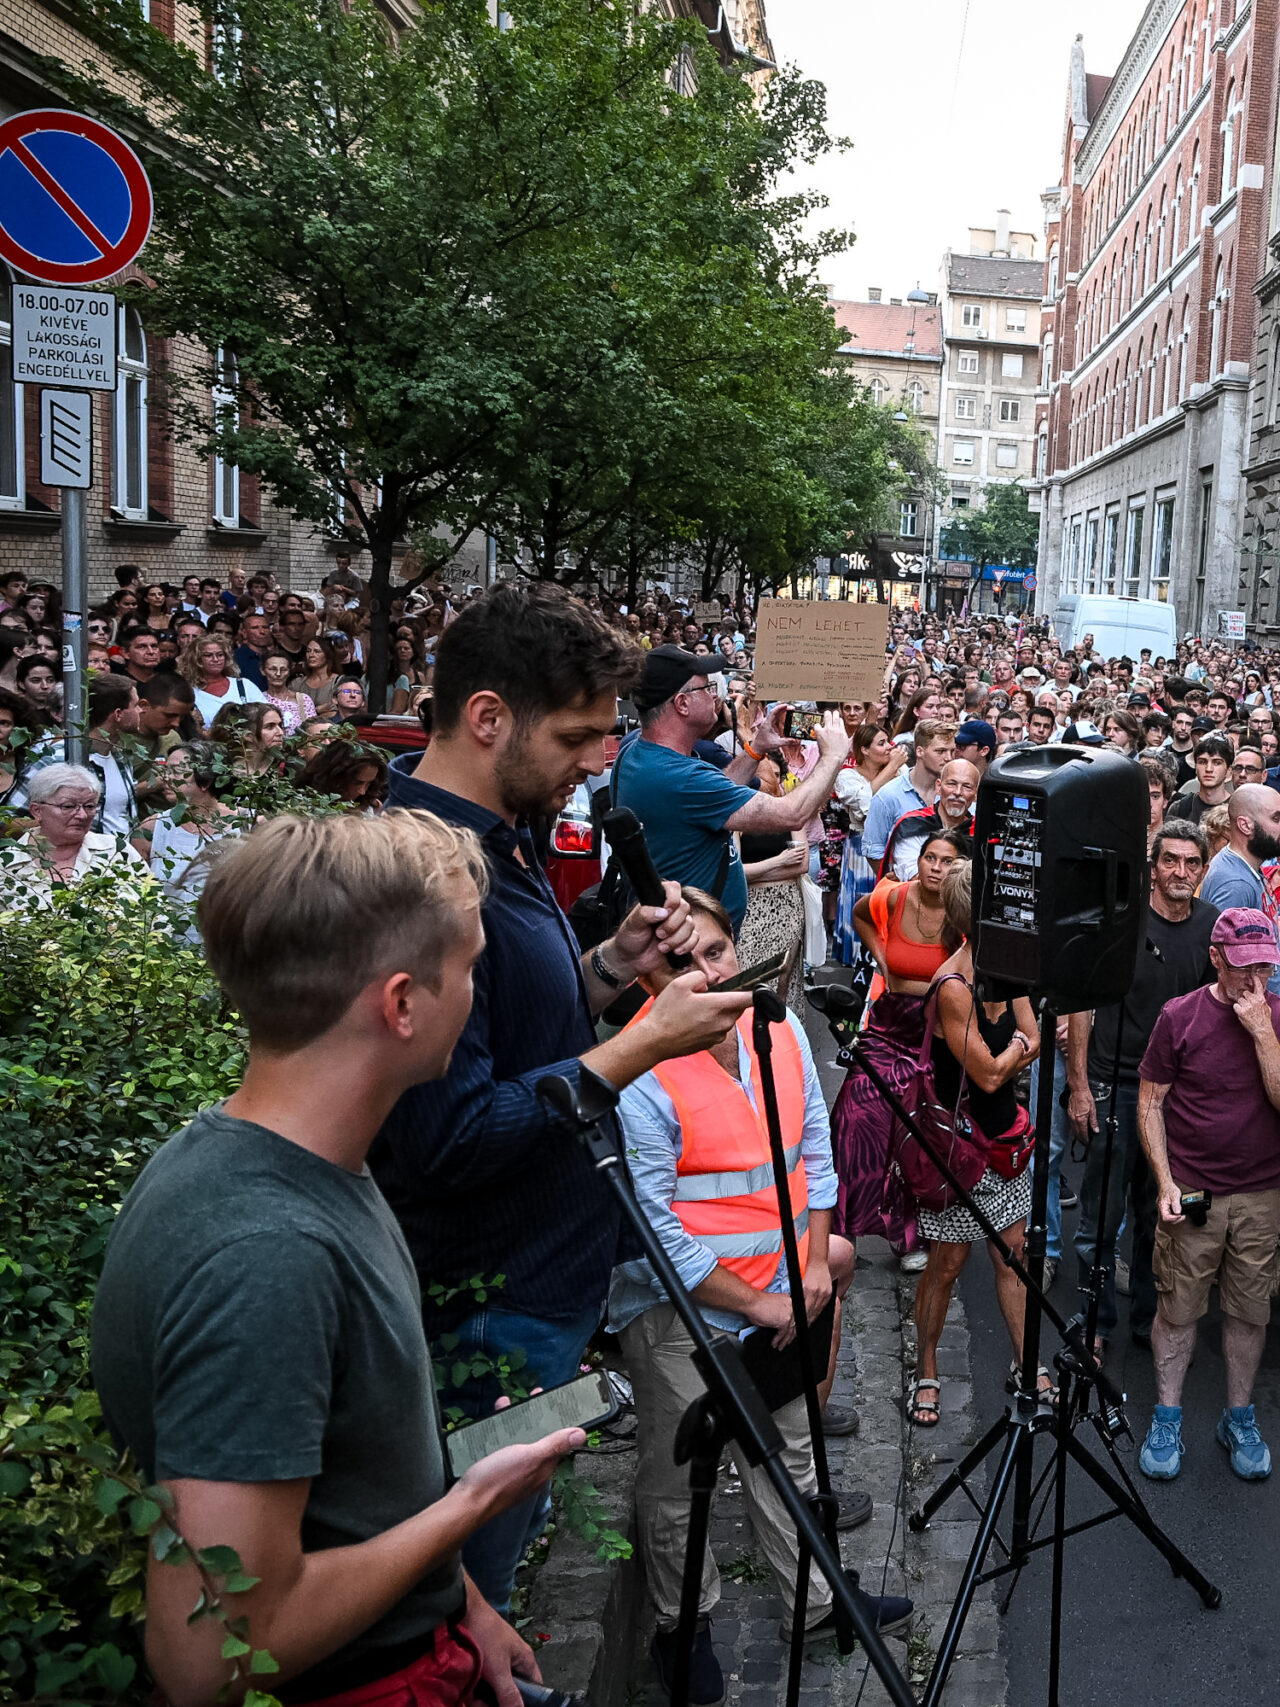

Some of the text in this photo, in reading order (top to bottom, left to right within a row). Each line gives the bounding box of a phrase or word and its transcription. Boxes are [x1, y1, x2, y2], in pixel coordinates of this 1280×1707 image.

[19, 293, 108, 316] 18.00-07.00
[40, 315, 88, 331] KIVÉVE
[27, 330, 101, 349] LAKOSSÁGI
[29, 347, 103, 365] PARKOLÁSI
[18, 362, 111, 382] ENGEDÉLLYEL
[767, 617, 865, 632] NEM LEHET
[1000, 885, 1035, 899] VONYX
